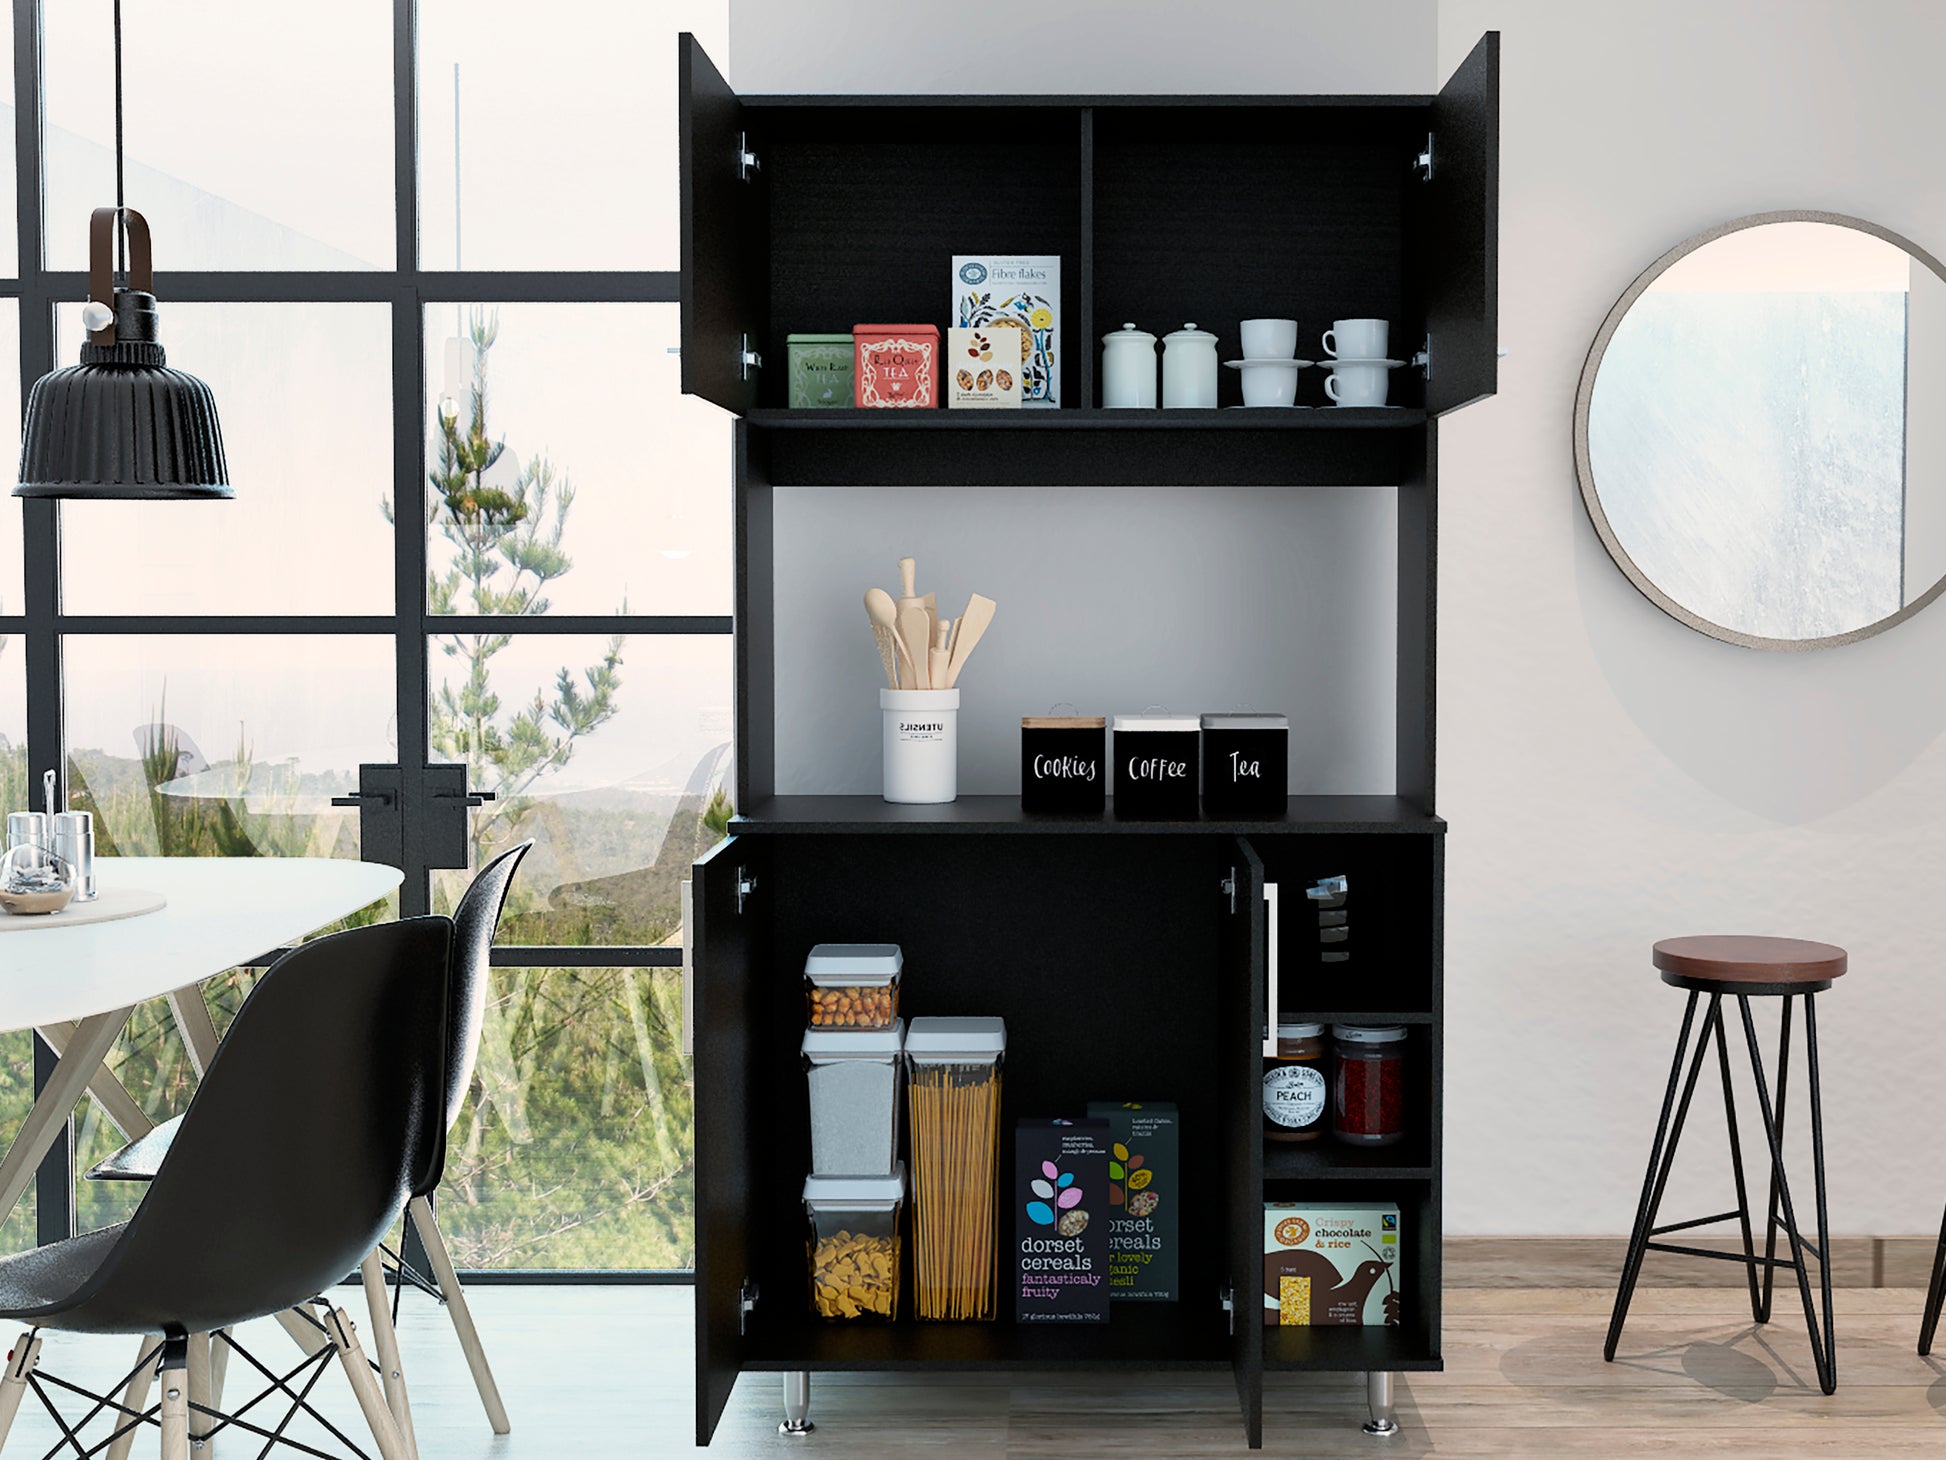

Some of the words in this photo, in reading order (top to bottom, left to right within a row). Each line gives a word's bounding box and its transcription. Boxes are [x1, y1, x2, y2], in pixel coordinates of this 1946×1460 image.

[991, 267, 1017, 280] Fibre
[1018, 267, 1047, 280] flakes
[883, 366, 909, 378] TEA
[1229, 751, 1262, 782] Tea
[1276, 1091, 1312, 1101] PEACH
[1109, 1217, 1154, 1233] orset
[1315, 1217, 1354, 1228] Crispy
[1315, 1229, 1372, 1238] chocolate
[1021, 1237, 1084, 1253] dorset
[1109, 1234, 1161, 1250] reals
[1315, 1239, 1325, 1248] &
[1328, 1239, 1351, 1248] rice
[1021, 1254, 1092, 1271] cereals
[1116, 1251, 1153, 1264] lovely
[1021, 1273, 1101, 1286] fantasticaly
[1021, 1286, 1060, 1299] fruity
